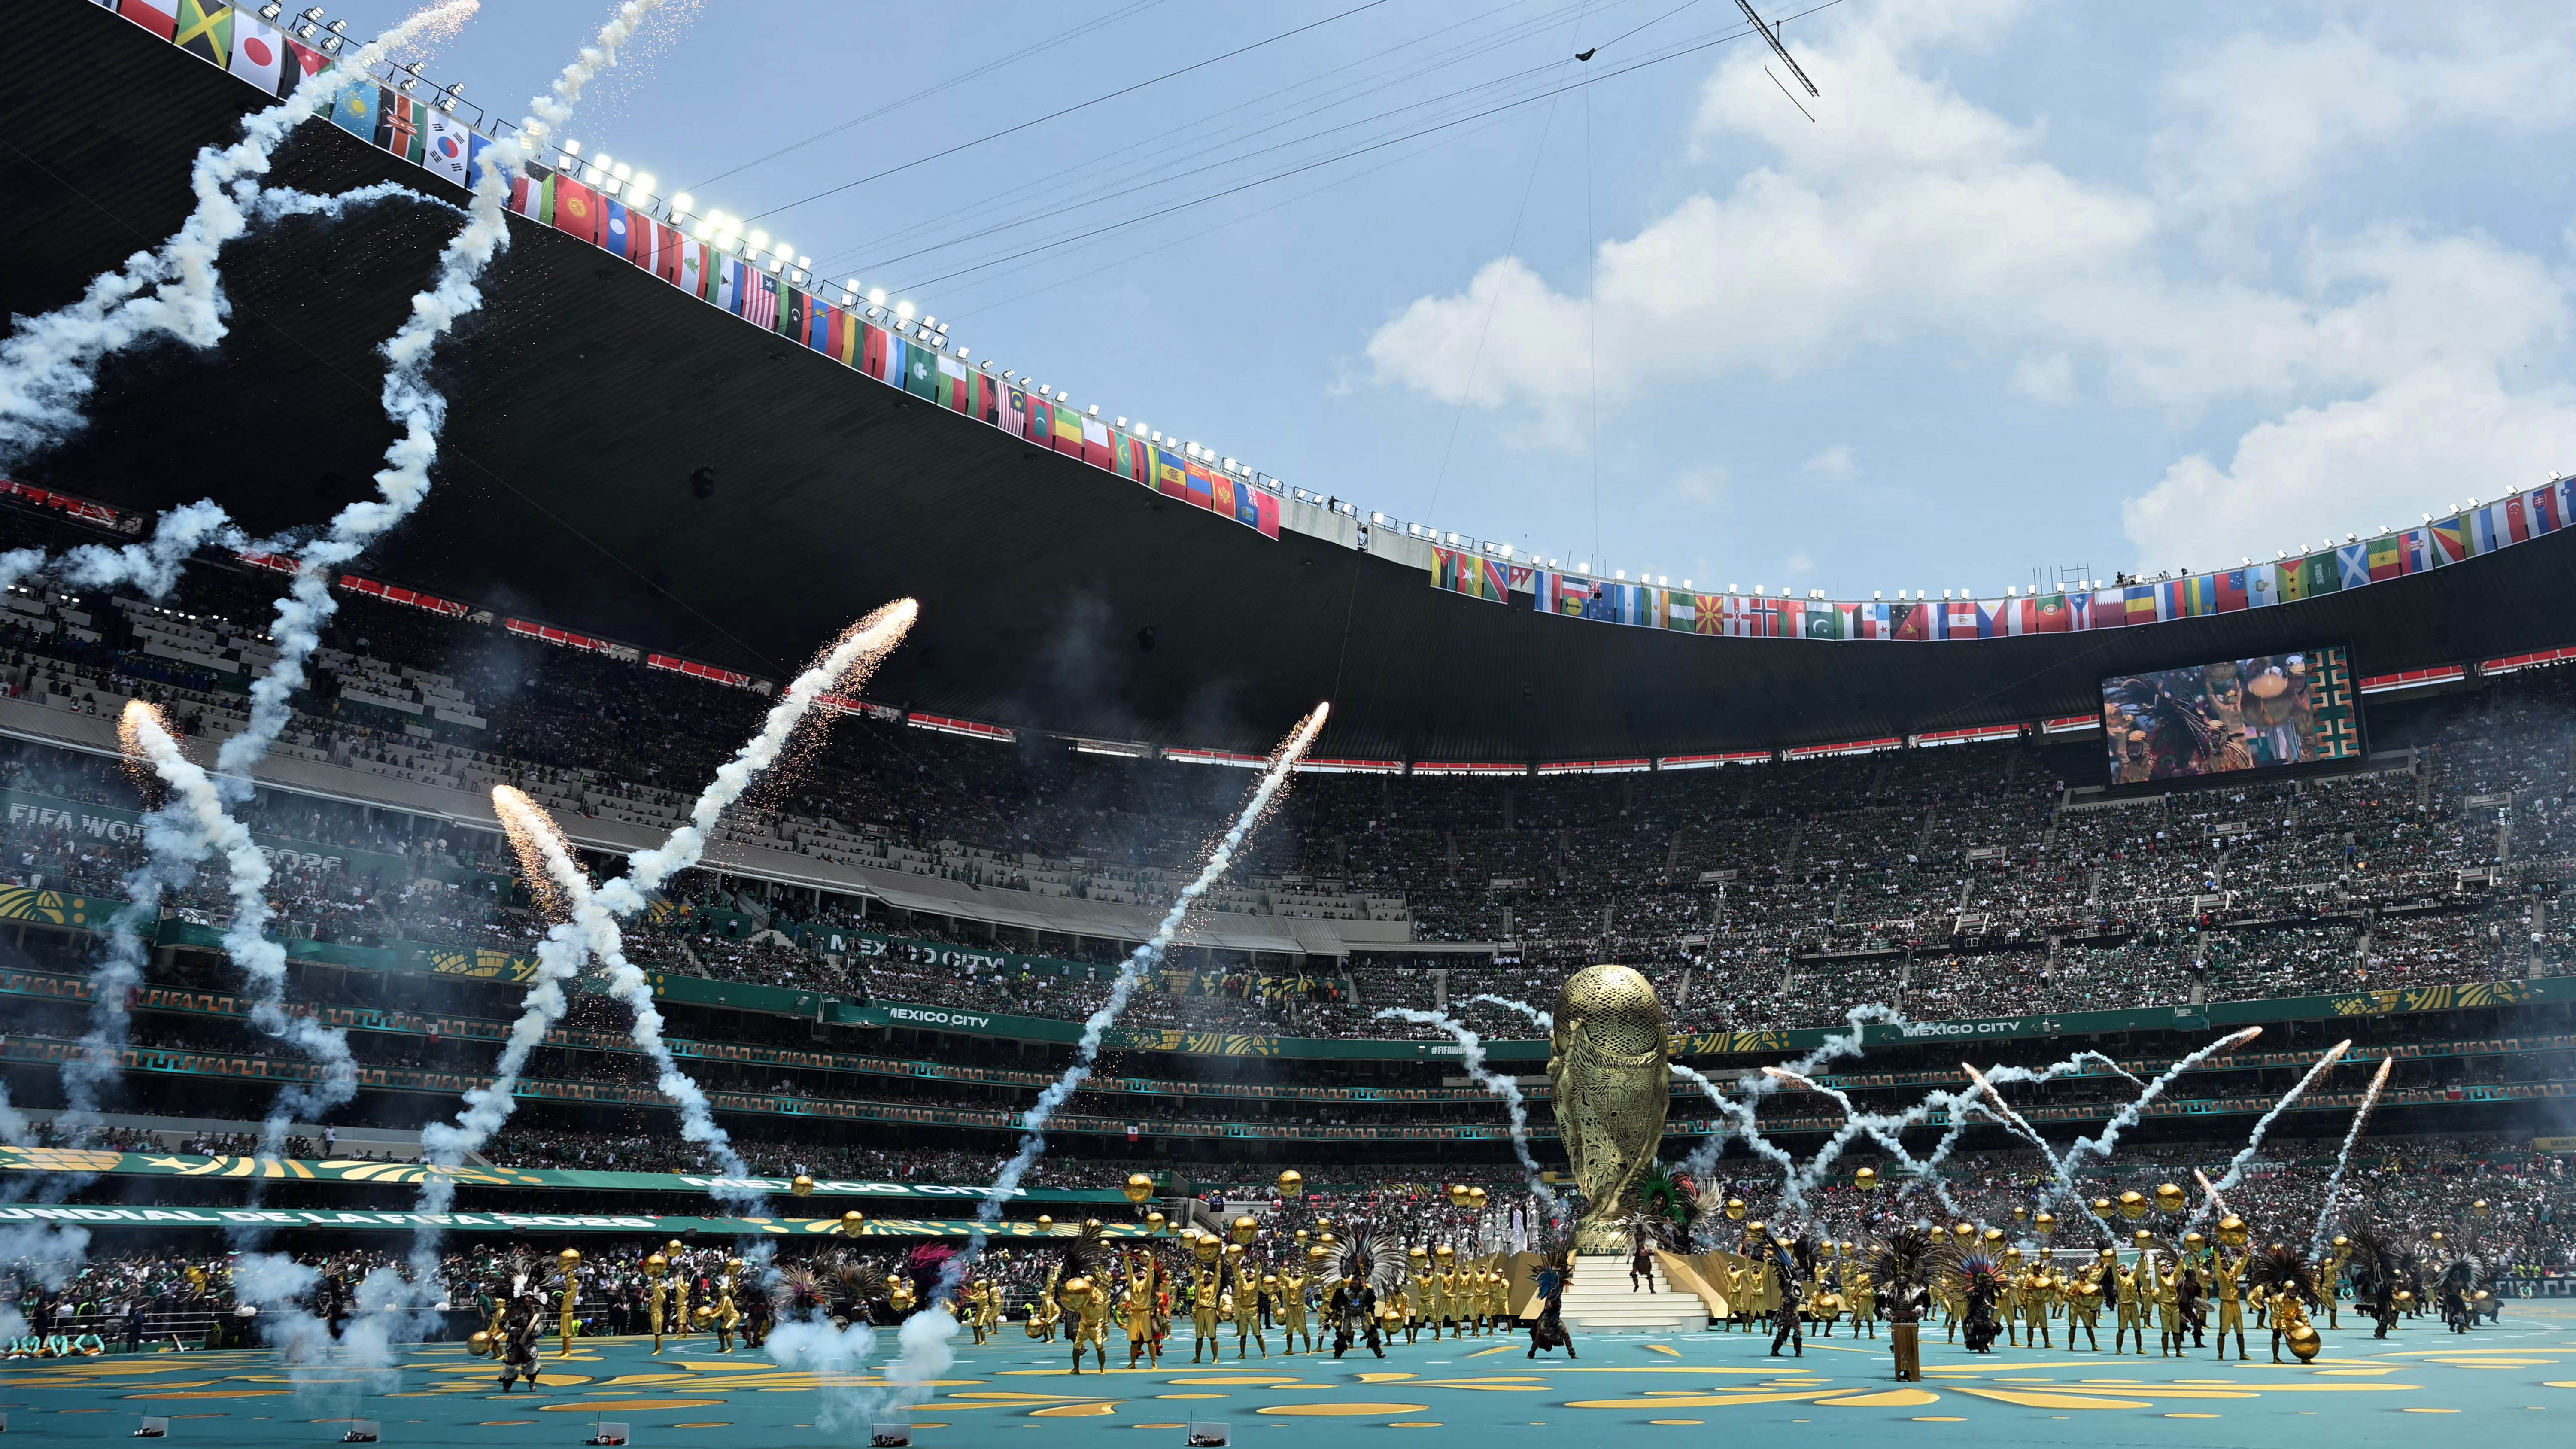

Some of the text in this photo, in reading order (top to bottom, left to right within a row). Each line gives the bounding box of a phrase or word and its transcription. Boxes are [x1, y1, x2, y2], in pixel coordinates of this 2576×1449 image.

[8, 803, 73, 834] FIFA
[890, 1007, 989, 1028] MEXICO CITY
[1903, 1021, 2020, 1037] MEXICO CITY
[10, 975, 58, 995] FIFA
[149, 990, 192, 1009] FIFA
[693, 1043, 723, 1058] FIFA
[779, 1051, 808, 1065] FIFA
[860, 1059, 886, 1072] FIFA
[935, 1066, 961, 1078] FIFA
[1008, 1072, 1031, 1084] FIFA
[1149, 1081, 1175, 1094] FIFA
[1224, 1085, 1250, 1096] FIFA
[1300, 1088, 1326, 1098] FIFA
[1376, 1089, 1403, 1100] FIFA
[1452, 1089, 1481, 1099] FIFA
[1841, 1076, 1868, 1086] FIFA
[1921, 1072, 1949, 1082] FIFA
[2263, 1053, 2296, 1065] FIFA
[2357, 1047, 2390, 1059] FIFA
[2453, 1041, 2489, 1054] FIFA
[183, 1056, 227, 1073] FIFA
[424, 1074, 461, 1090] FIFA
[528, 1082, 564, 1097] FIFA
[718, 1095, 747, 1109] FIFA
[803, 1102, 831, 1115] FIFA
[883, 1107, 909, 1120] FIFA
[958, 1112, 983, 1125] FIFA
[1174, 1124, 1199, 1134] FIFA
[1249, 1127, 1276, 1137] FIFA
[1325, 1128, 1352, 1138] FIFA
[1403, 1128, 1431, 1138] FIFA
[1482, 1127, 1509, 1137] FIFA
[1793, 1118, 1821, 1129] FIFA
[2037, 1109, 2068, 1119] FIFA
[2211, 1100, 2244, 1111] FIFA
[2497, 1086, 2533, 1098] FIFA
[216, 1212, 301, 1222] DE
[298, 1213, 381, 1223] LA
[374, 1214, 495, 1224] FIFA
[494, 1216, 657, 1227] 2026
